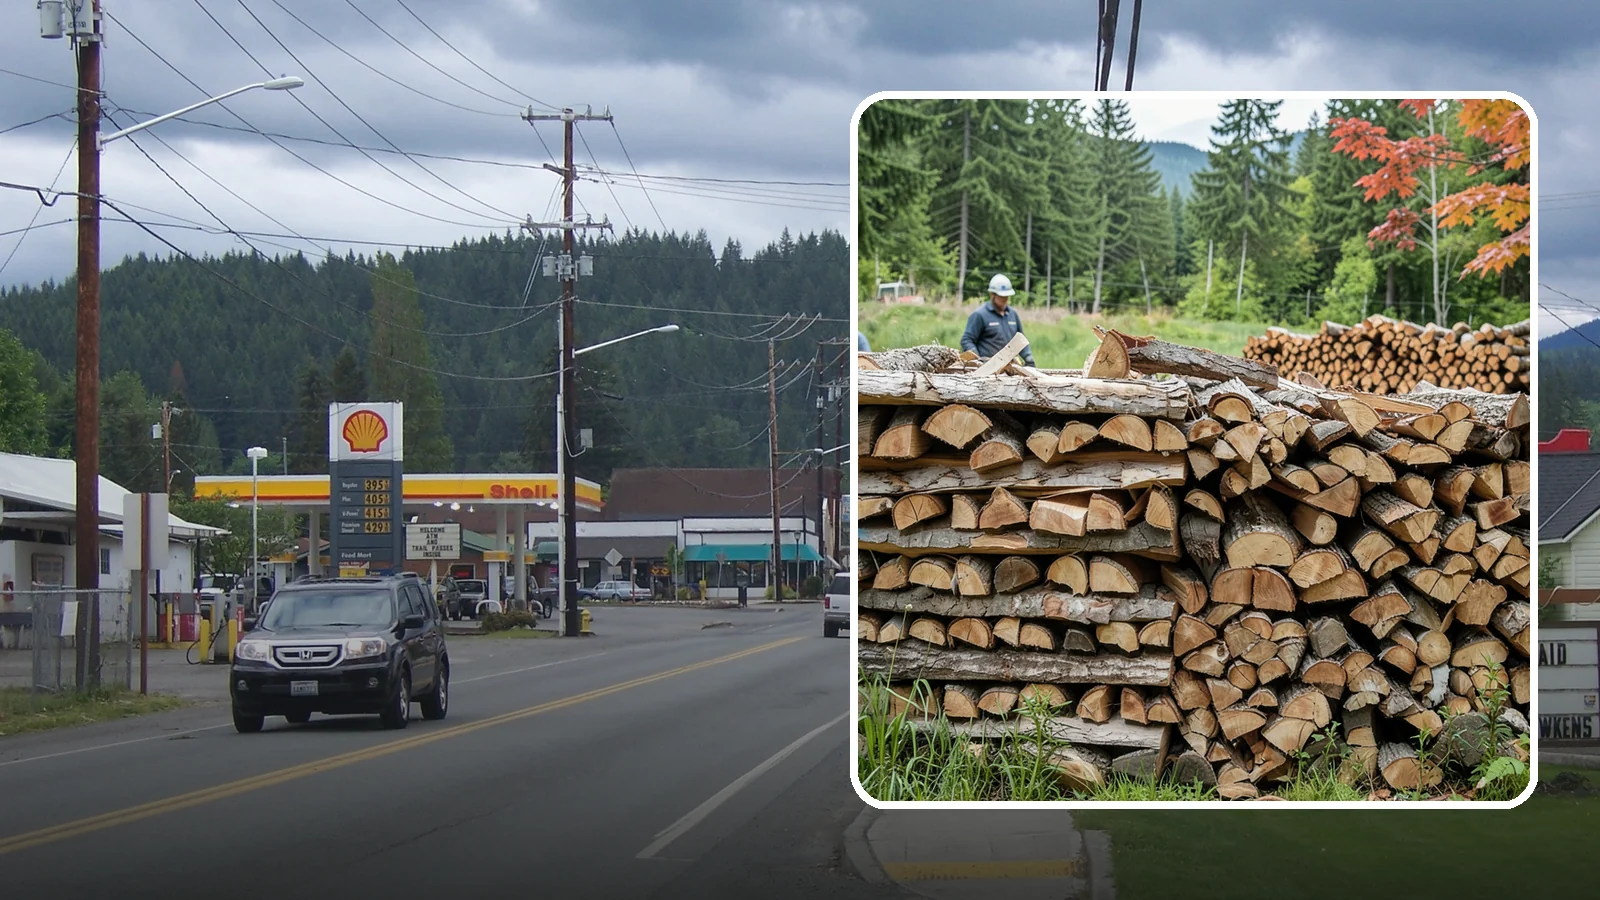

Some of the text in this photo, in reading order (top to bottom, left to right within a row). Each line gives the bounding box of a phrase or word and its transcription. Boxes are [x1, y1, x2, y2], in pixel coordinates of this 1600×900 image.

[366, 480, 384, 490] 395
[490, 484, 547, 499] Shell
[366, 494, 384, 504] 405
[366, 508, 384, 518] 415
[366, 522, 384, 533] 429
